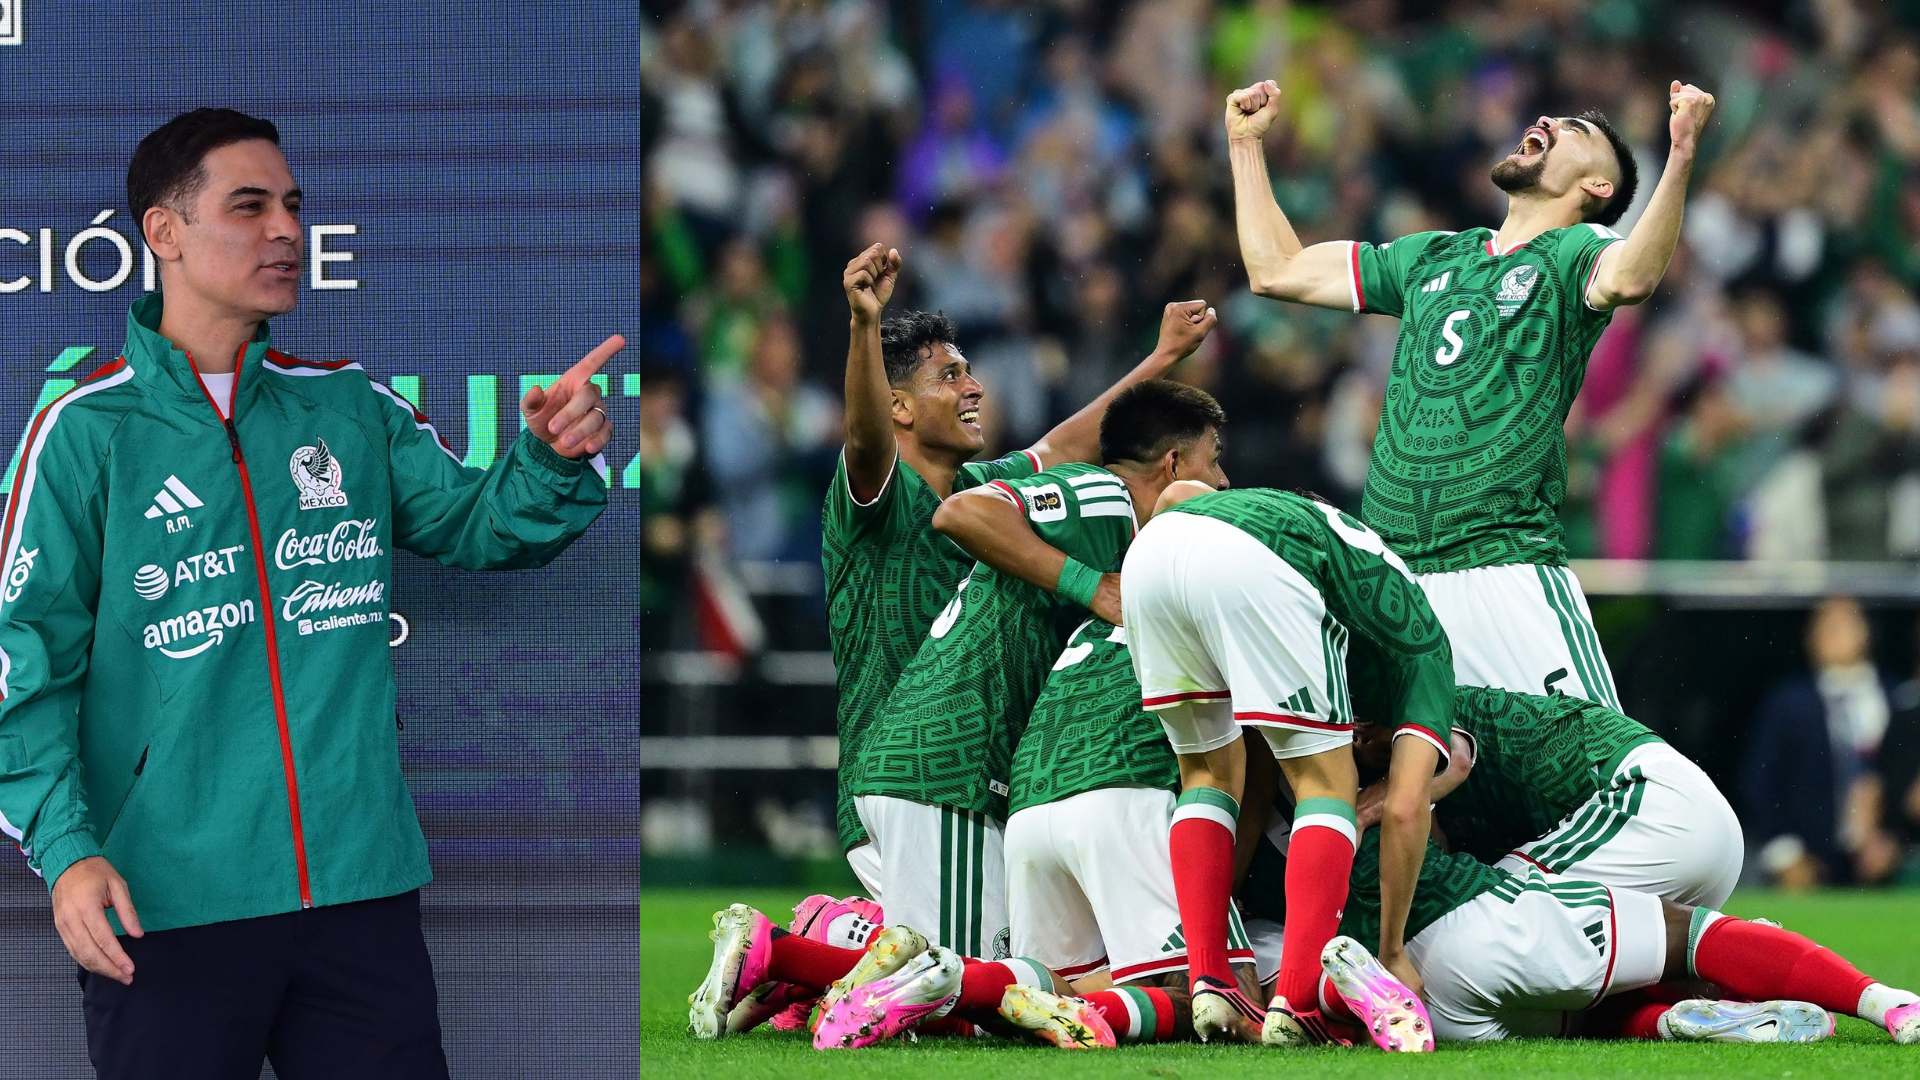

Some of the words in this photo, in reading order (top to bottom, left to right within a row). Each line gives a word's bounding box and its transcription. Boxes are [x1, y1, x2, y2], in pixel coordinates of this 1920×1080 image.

[0, 209, 156, 293] CIÓ
[310, 224, 358, 290] E
[1435, 310, 1471, 366] 5
[166, 515, 194, 534] R.M.
[300, 495, 346, 509] MÉXICO
[275, 518, 379, 570] Coca-Cola
[281, 580, 385, 621] Caliente
[313, 611, 384, 631] caliente.mx
[143, 599, 255, 649] amazon
